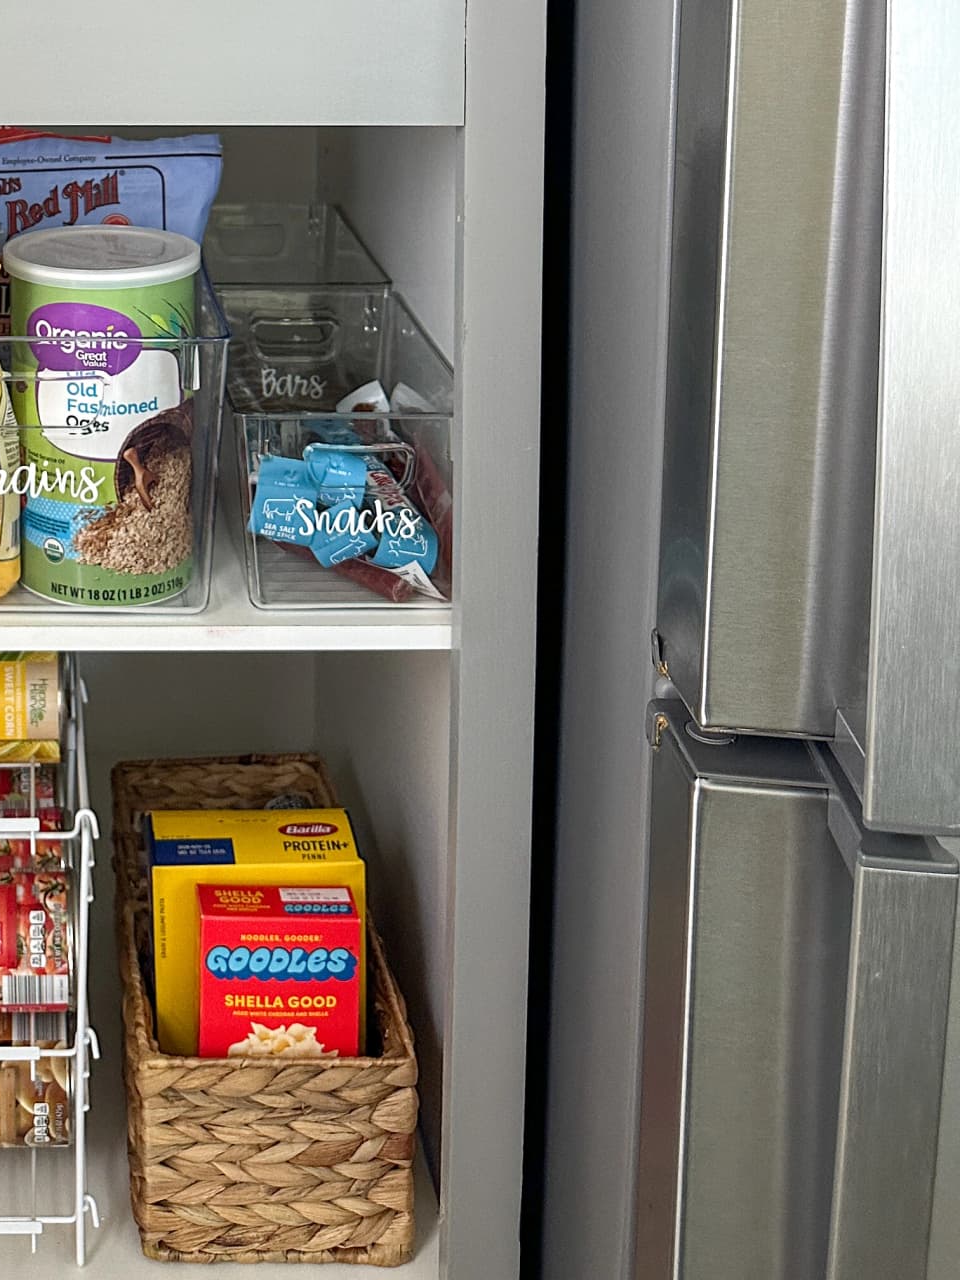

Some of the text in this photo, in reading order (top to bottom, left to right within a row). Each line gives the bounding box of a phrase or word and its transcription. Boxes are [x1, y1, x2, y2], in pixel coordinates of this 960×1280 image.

[64, 155, 97, 164] Company
[5, 170, 121, 238] Red Mill
[35, 319, 128, 354] Organic
[75, 349, 108, 361] Great
[83, 358, 108, 368] Value
[260, 367, 328, 399] Bars
[66, 382, 98, 398] Old
[67, 397, 159, 417] Fashioned
[295, 499, 422, 539] Snacks
[264, 522, 295, 534] SEA SALT
[277, 531, 296, 541] STICK
[51, 582, 67, 595] NET
[68, 585, 85, 599] WT
[88, 588, 100, 600] 18
[102, 588, 115, 601] OZ
[117, 588, 127, 601] (1
[129, 586, 142, 598] LB
[143, 585, 151, 597] 2
[151, 582, 166, 596] OZ)
[4, 666, 15, 737] SWEET CORN
[285, 824, 332, 834] Barilla
[283, 840, 349, 852] PROTEIN+
[214, 890, 265, 898] SHELLA
[219, 896, 262, 904] GOOD
[284, 904, 351, 913] GOODLES
[224, 994, 337, 1009] SHELLA GOOD
